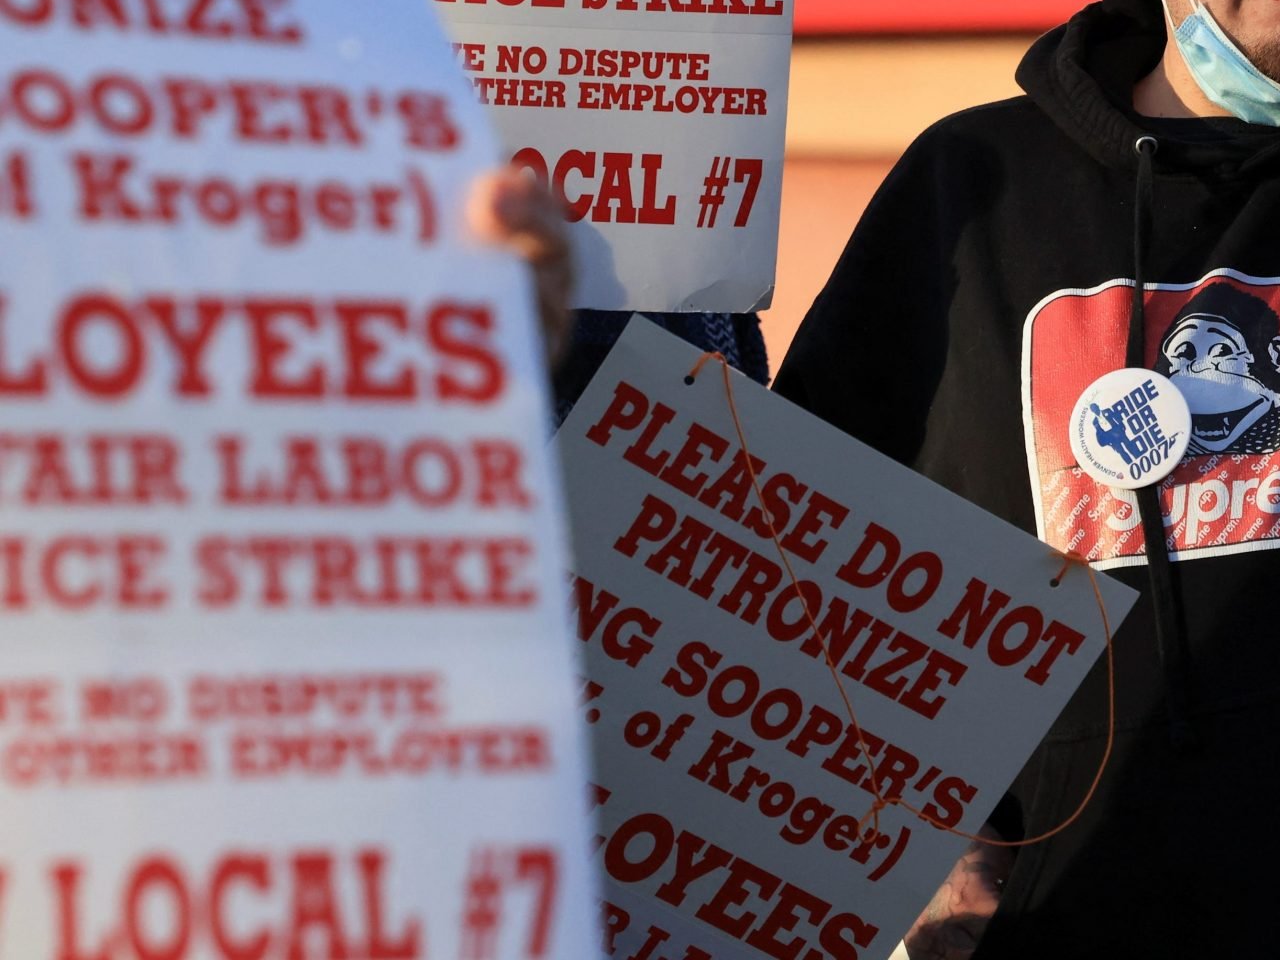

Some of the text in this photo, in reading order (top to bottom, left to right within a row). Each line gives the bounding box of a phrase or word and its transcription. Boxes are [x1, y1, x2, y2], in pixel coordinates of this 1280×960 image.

[468, 77, 767, 116] THER EMPLOYER
[496, 45, 547, 75] NO
[558, 48, 710, 80] DISPUTE
[5, 68, 462, 152] OOPER'S
[70, 150, 438, 247] Kroger)
[697, 156, 763, 228] #7
[0, 290, 507, 404] LOYEES
[1127, 404, 1157, 435] OR
[1129, 423, 1165, 460] DIE
[215, 433, 534, 510] LABOR
[195, 533, 537, 610] STRIKE
[585, 381, 1087, 687] PLEASE DO NOT
[613, 494, 969, 721] PATRONIZE
[662, 640, 979, 832] SOOPER'S
[623, 710, 912, 882] of Kroger)
[48, 847, 424, 960] LOCAL
[462, 845, 560, 960] #7
